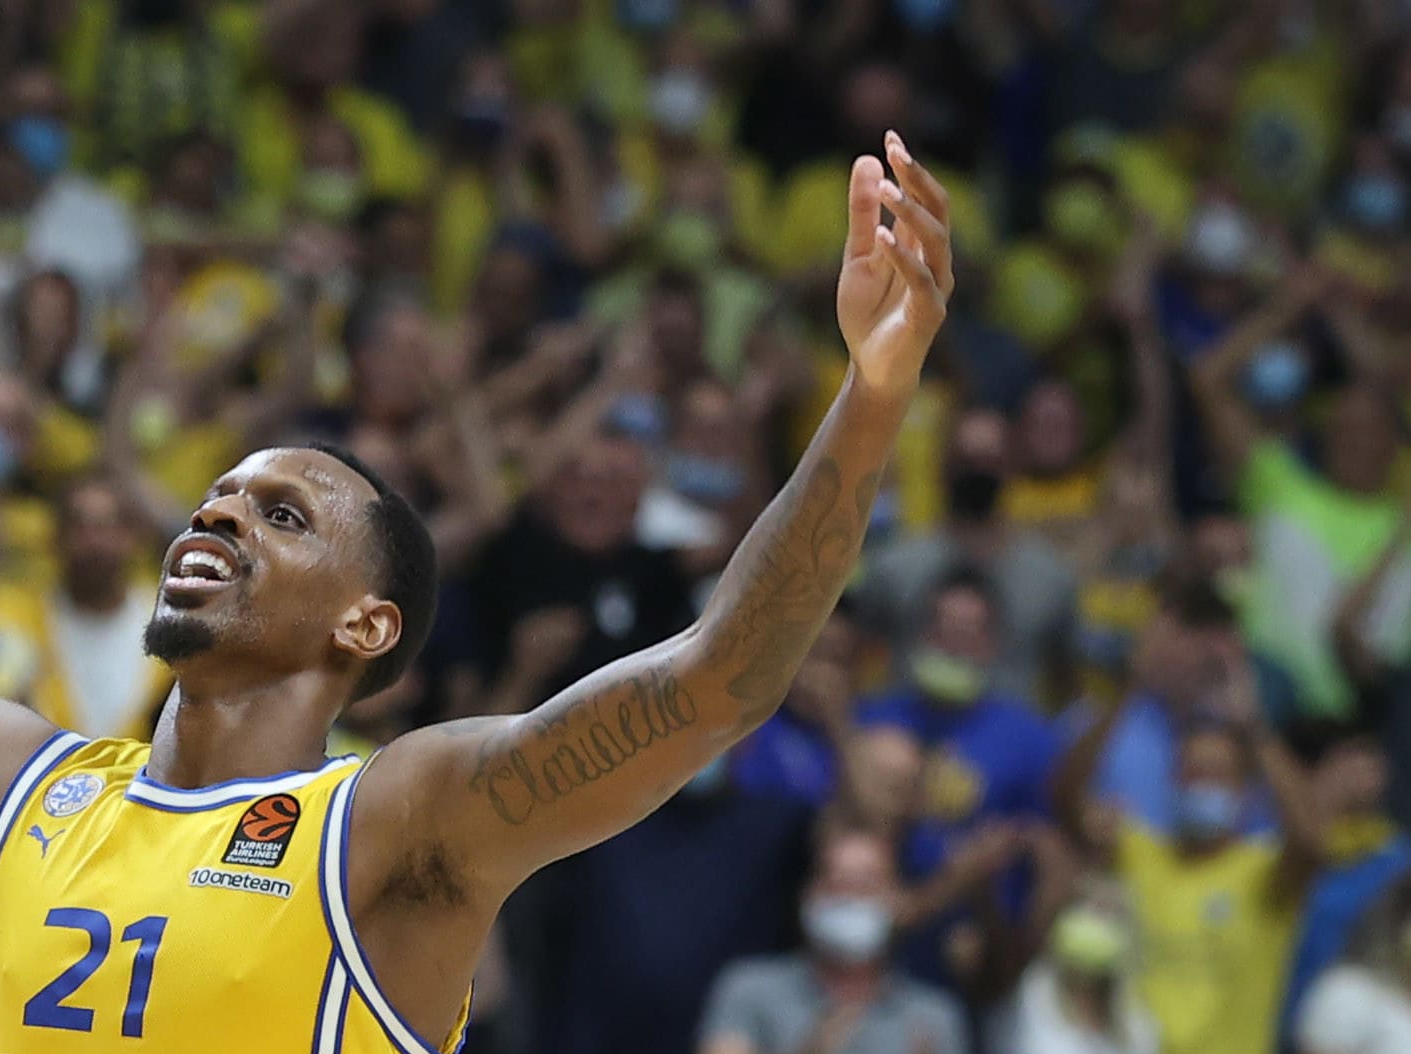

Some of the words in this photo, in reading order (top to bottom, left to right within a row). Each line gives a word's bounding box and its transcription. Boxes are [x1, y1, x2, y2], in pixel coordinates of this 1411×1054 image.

[234, 840, 283, 851] TURKISH
[230, 848, 279, 860] AIRLINES
[22, 907, 169, 1039] 21
